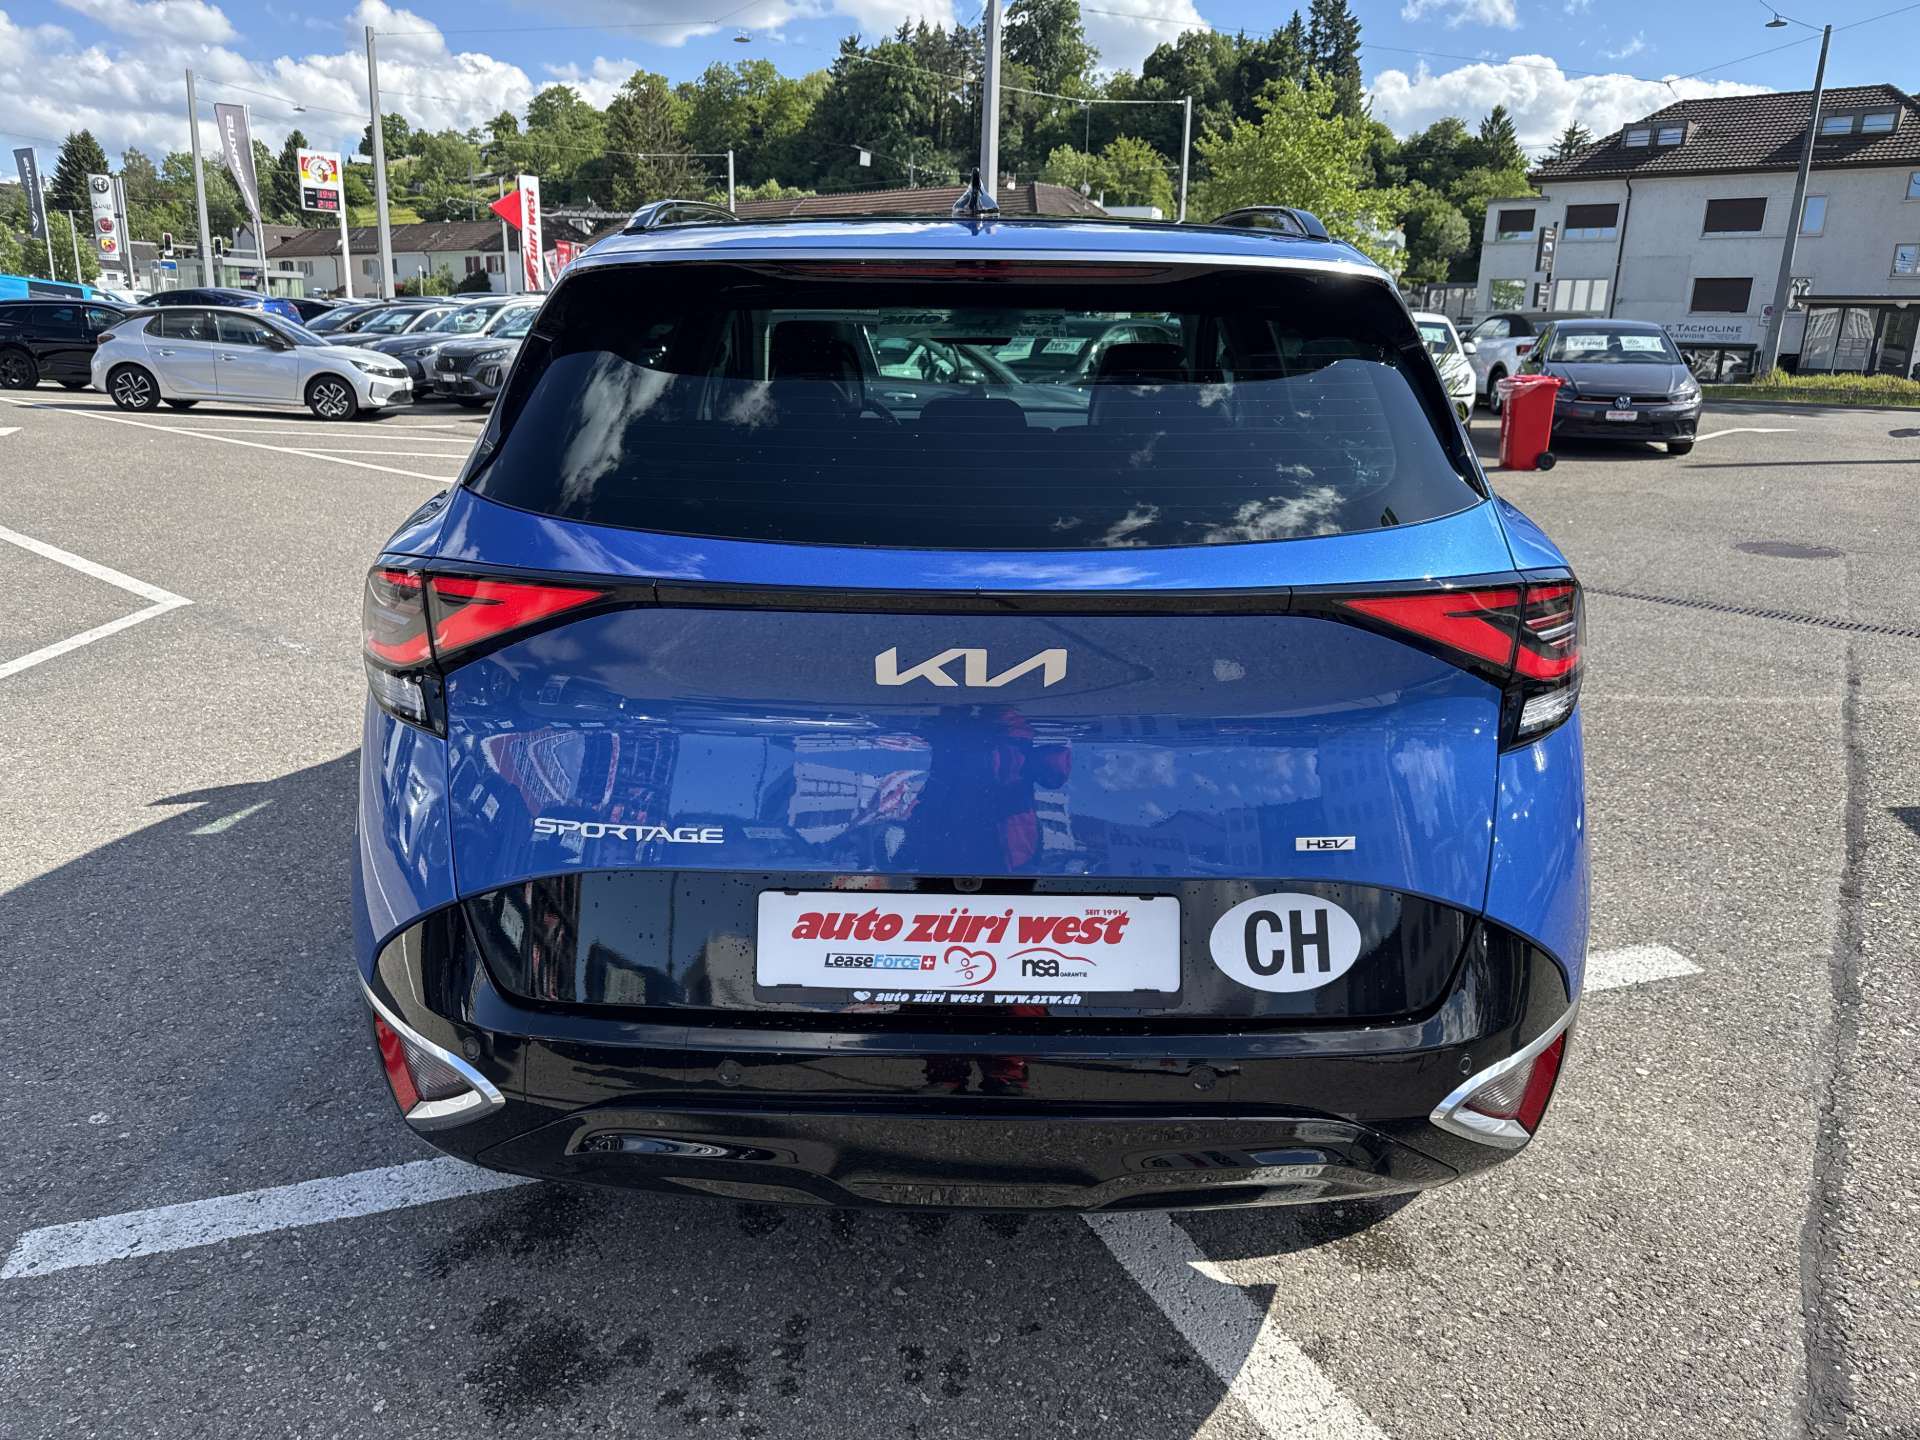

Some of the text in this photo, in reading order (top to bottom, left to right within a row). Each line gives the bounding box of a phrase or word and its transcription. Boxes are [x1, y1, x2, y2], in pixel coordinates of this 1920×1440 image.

[1676, 324, 1743, 333] TACHOLINE
[875, 647, 1067, 687] KIA
[534, 817, 725, 844] SPORTAGE
[1306, 839, 1349, 849] HEV
[792, 903, 1130, 945] auto züri west
[1244, 909, 1331, 976] CH
[825, 953, 920, 969] LeaseForce
[1022, 959, 1059, 977] nsa
[875, 989, 1082, 1005] auto züri west www.azw.ch
